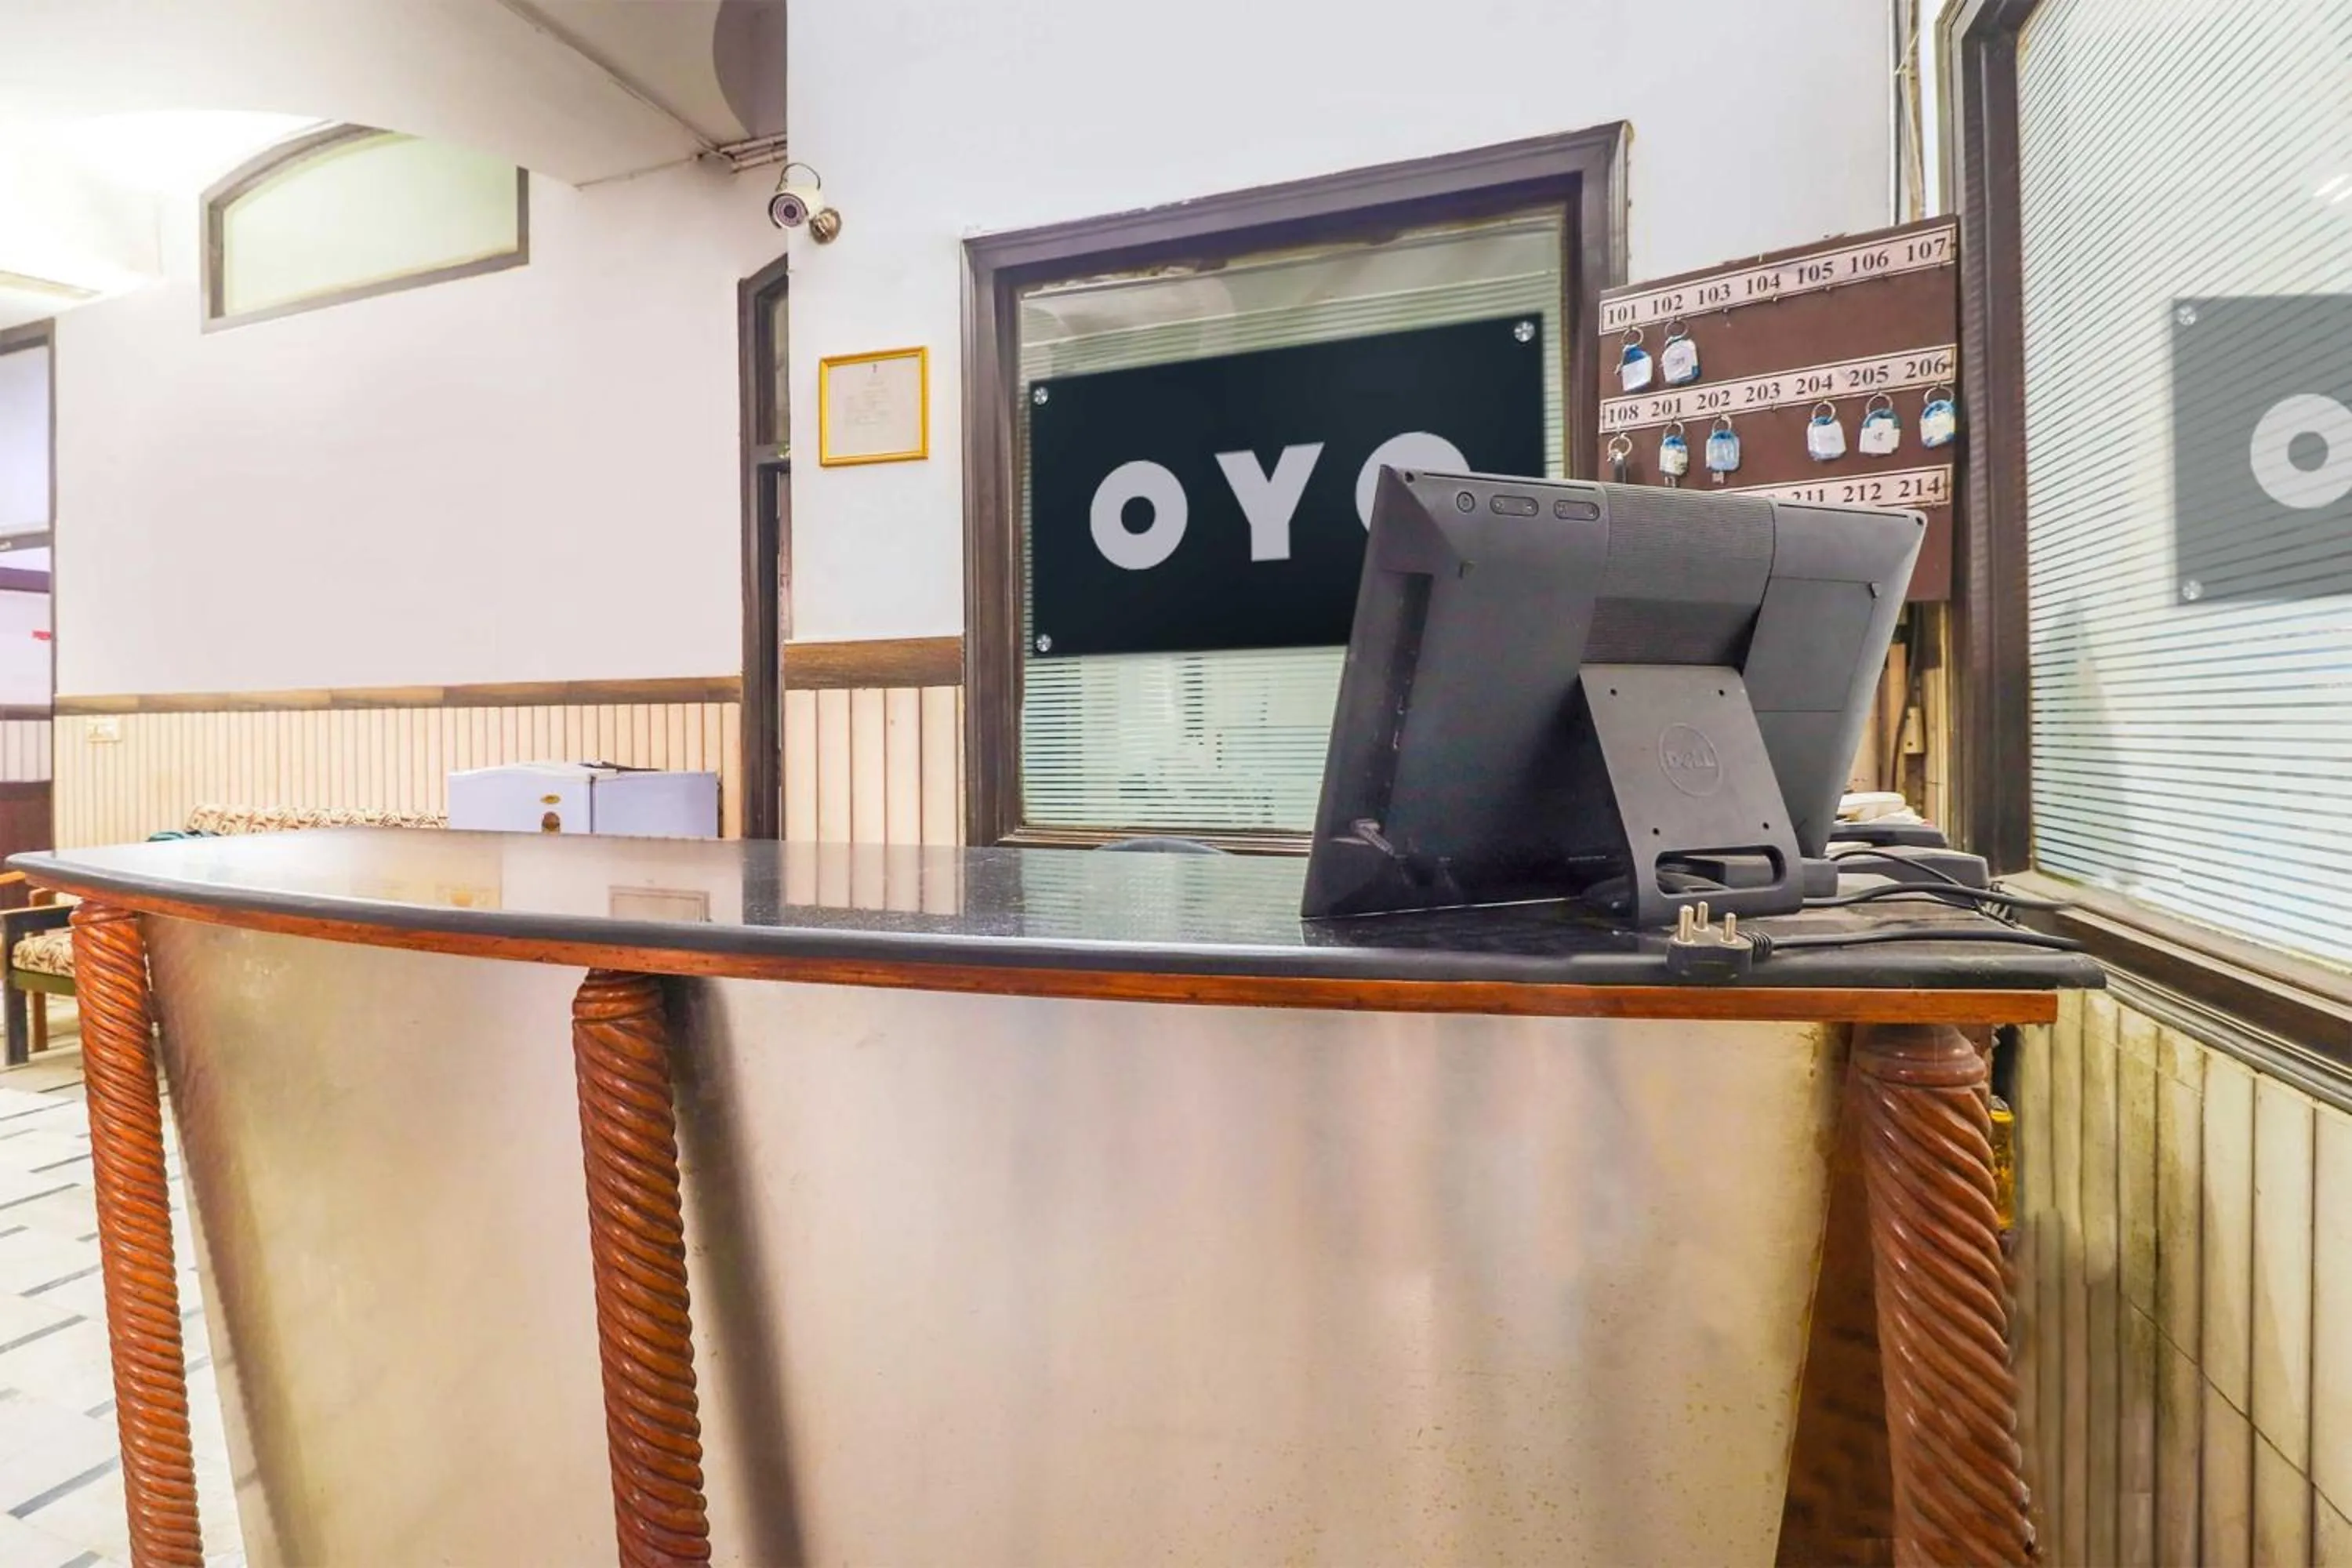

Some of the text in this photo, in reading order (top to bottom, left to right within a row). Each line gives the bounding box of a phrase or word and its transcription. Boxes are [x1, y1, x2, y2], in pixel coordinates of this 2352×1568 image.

[1609, 238, 1947, 325] 101 102 103 104 105 106 107
[1607, 357, 1946, 423] 108 201 202 203 204 205 206
[1843, 483, 1882, 503] 212
[1898, 477, 1940, 498] 214
